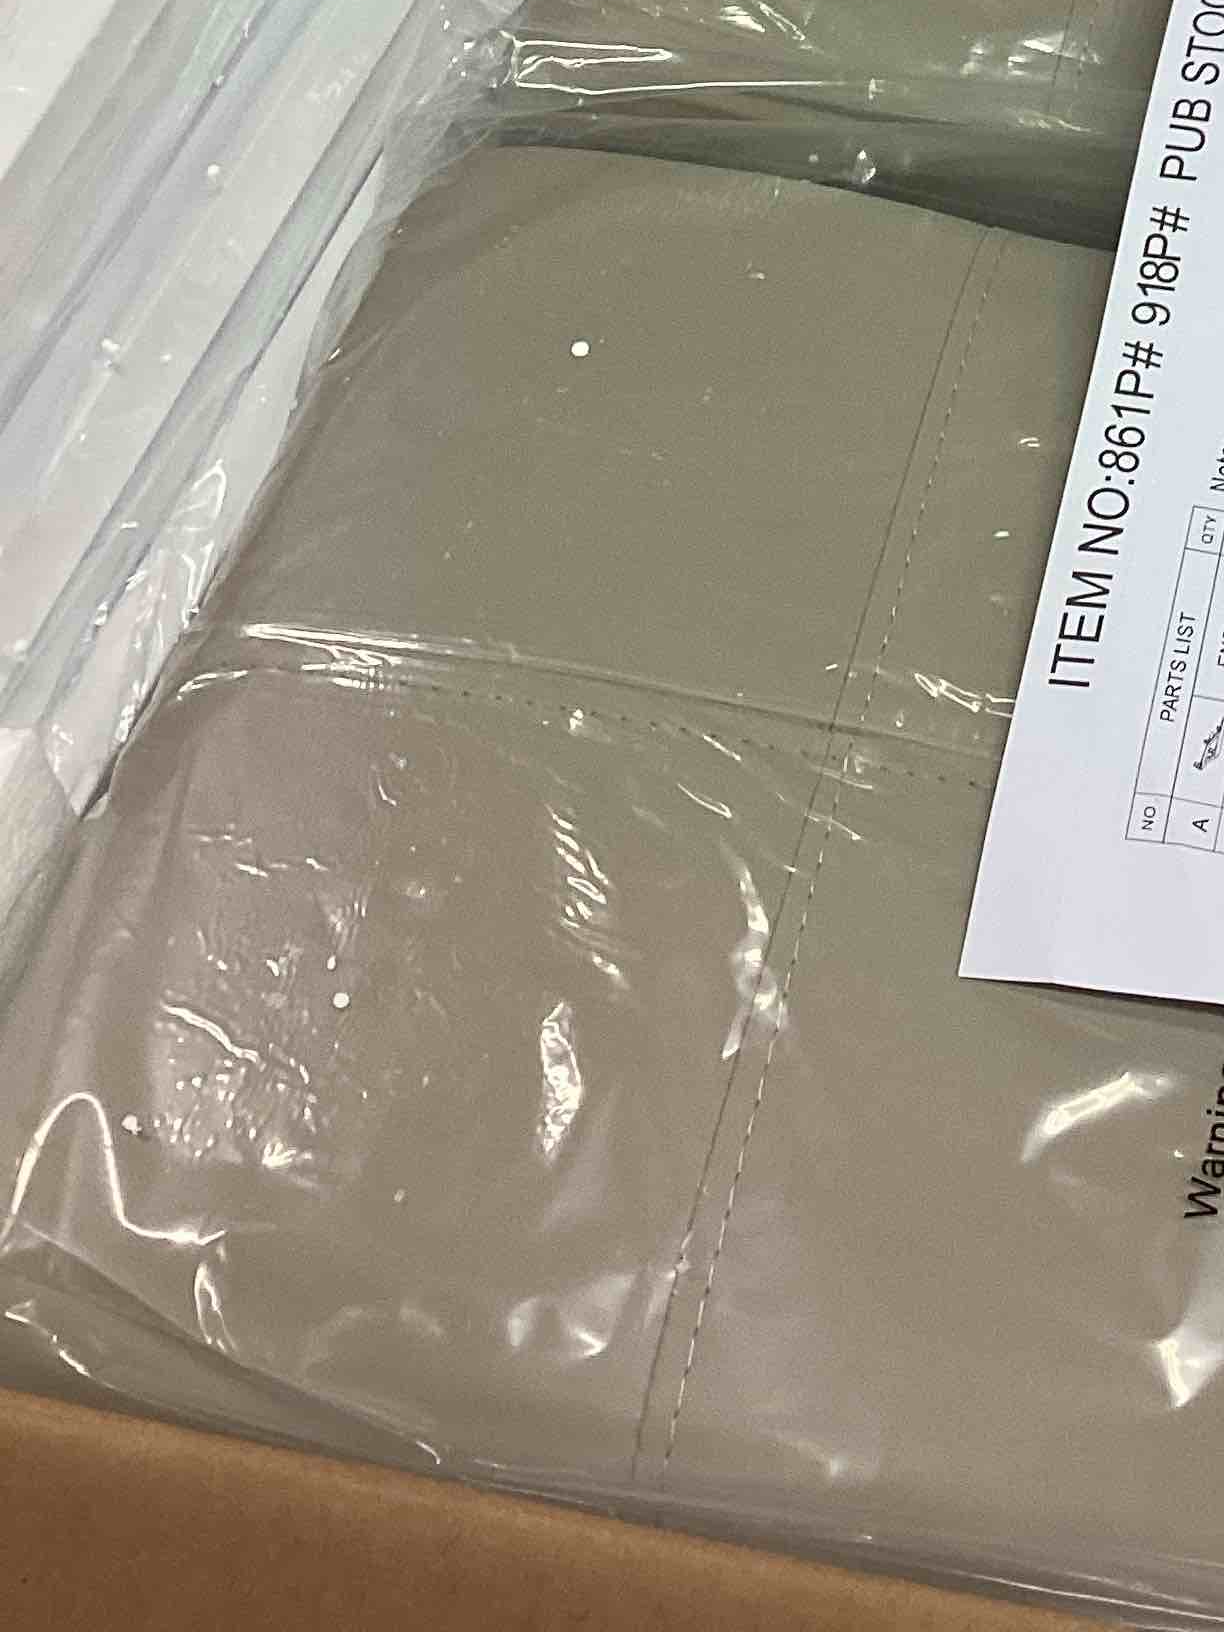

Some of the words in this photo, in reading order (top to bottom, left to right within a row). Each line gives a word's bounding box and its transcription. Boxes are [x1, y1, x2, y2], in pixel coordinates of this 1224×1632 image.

[1158, 98, 1212, 182] PUB
[1130, 205, 1191, 327] 918P#
[1077, 339, 1164, 556] NO:861P#
[1199, 514, 1218, 545] QTY
[1047, 568, 1115, 689] ITEM
[1173, 610, 1197, 655] LIST
[1158, 659, 1194, 723] PARTS
[1140, 805, 1157, 832] NO
[1190, 817, 1210, 834] A
